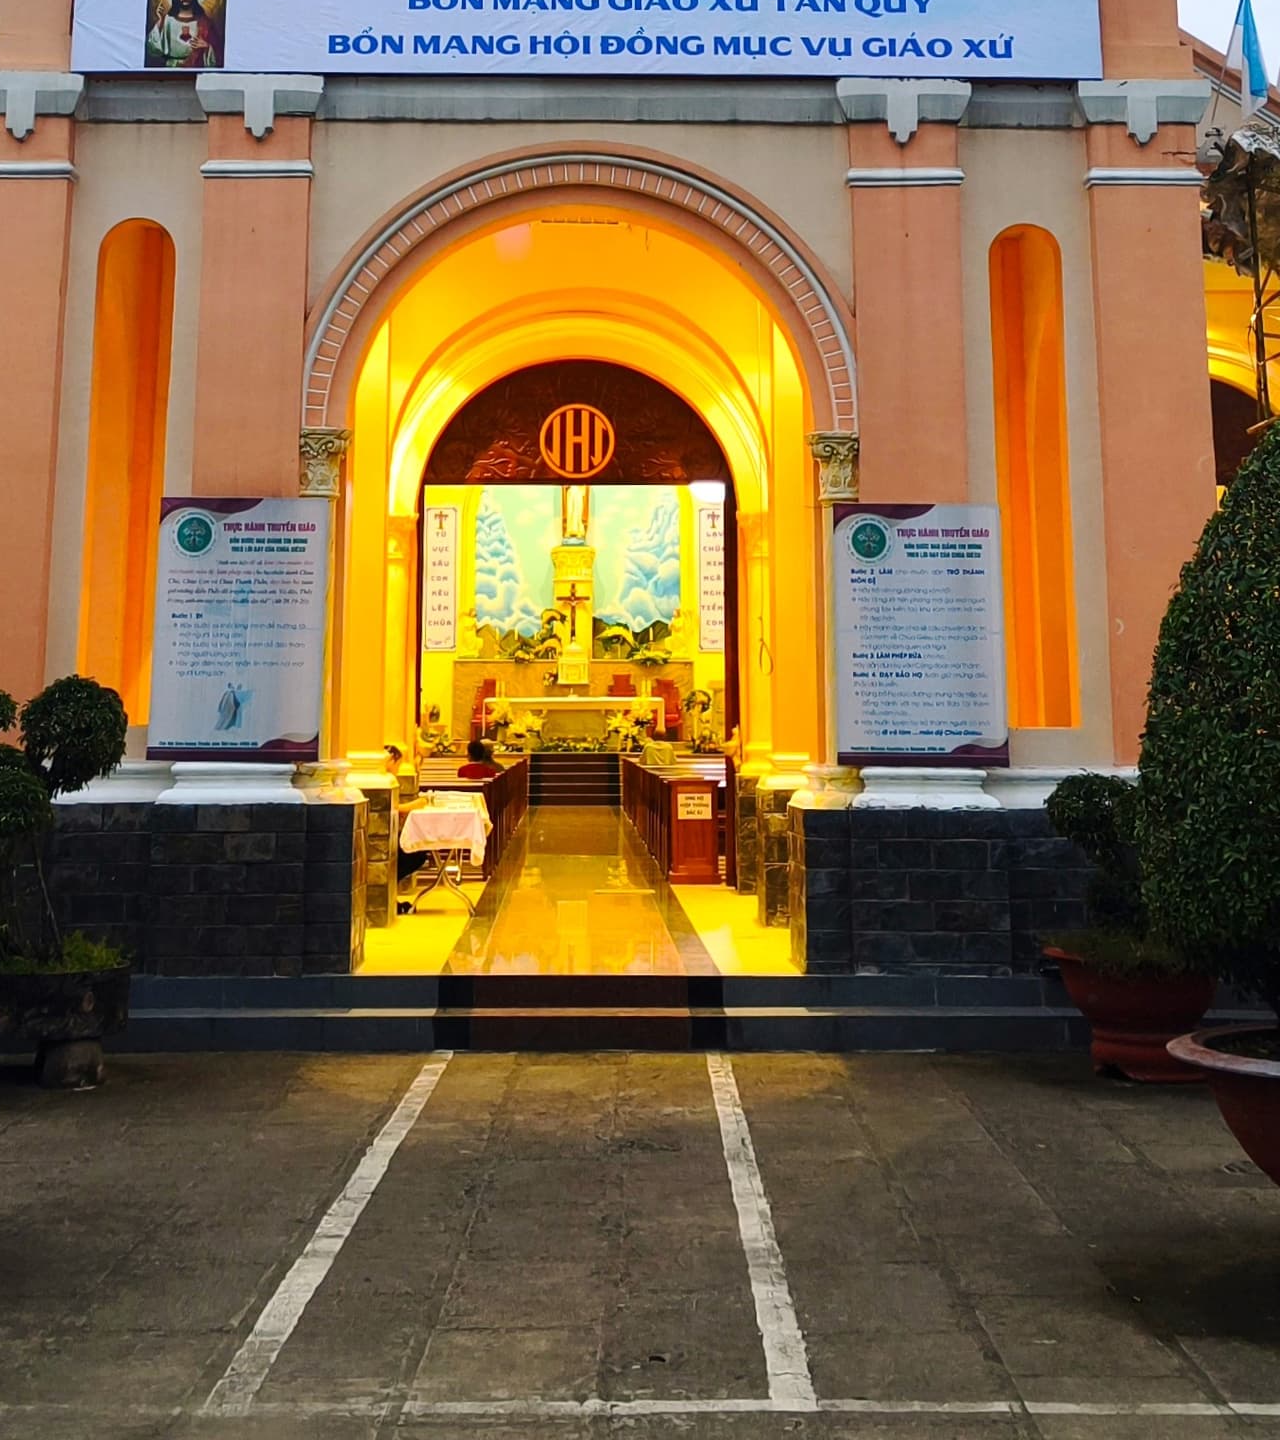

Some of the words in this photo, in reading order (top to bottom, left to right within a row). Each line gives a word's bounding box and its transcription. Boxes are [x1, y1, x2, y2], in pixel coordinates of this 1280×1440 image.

[328, 27, 404, 54] BỔN
[413, 35, 520, 58] MẠNG
[529, 30, 591, 59] HỘI
[600, 27, 705, 55] ĐỒNG
[713, 36, 793, 60] MỤC
[800, 37, 852, 61] VỤ
[862, 32, 953, 58] GIÁO
[963, 33, 1014, 59] XỨ
